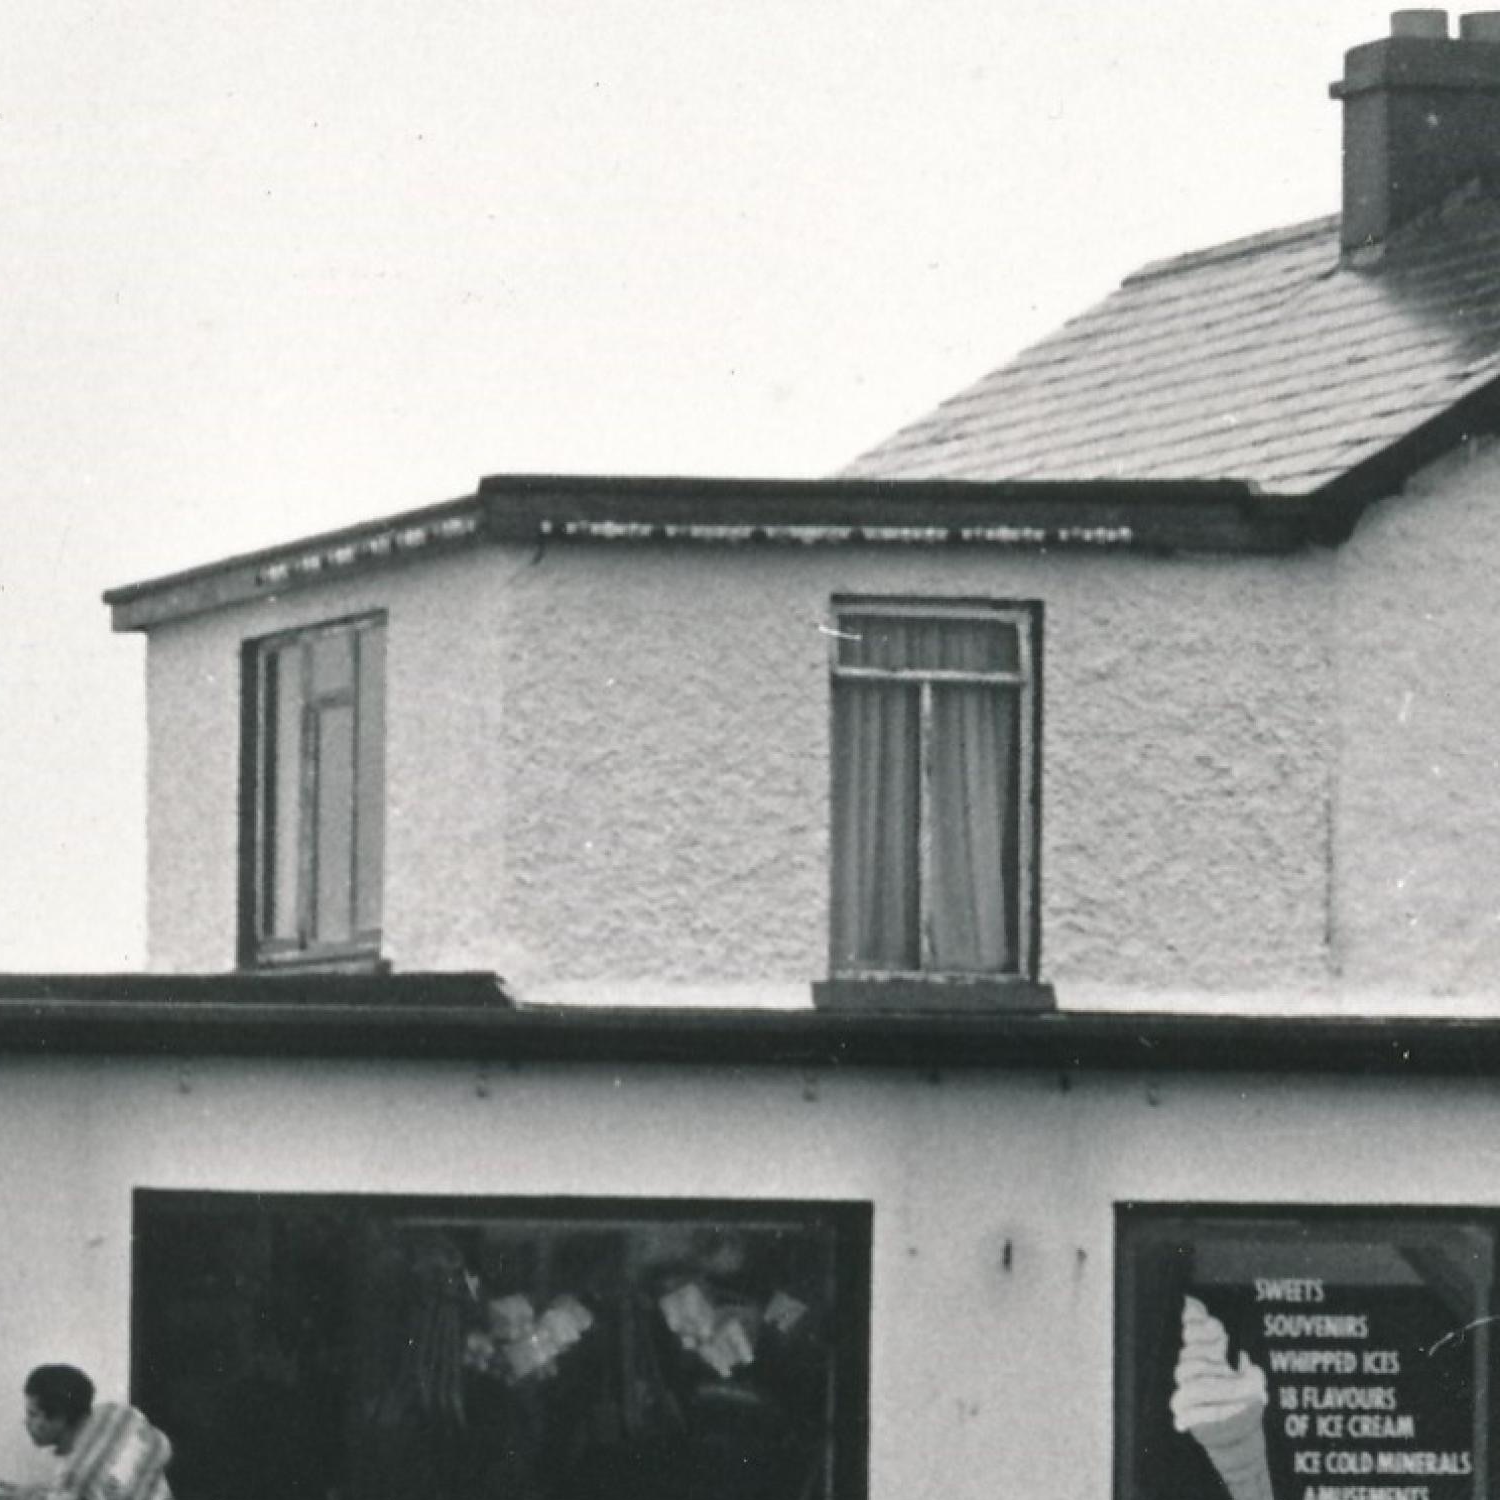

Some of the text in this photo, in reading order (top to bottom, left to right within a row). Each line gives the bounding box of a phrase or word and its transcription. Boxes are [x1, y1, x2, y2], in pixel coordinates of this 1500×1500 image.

[1255, 1278, 1324, 1302] SWEETS
[1264, 1314, 1368, 1338] SOUVENIRS
[1270, 1351, 1400, 1374] WHIPPED ICES
[1302, 1387, 1396, 1410] FLAVOURS
[1285, 1414, 1415, 1438] OF ICE CREAM
[1294, 1451, 1473, 1475] ICE COLD MINERALS
